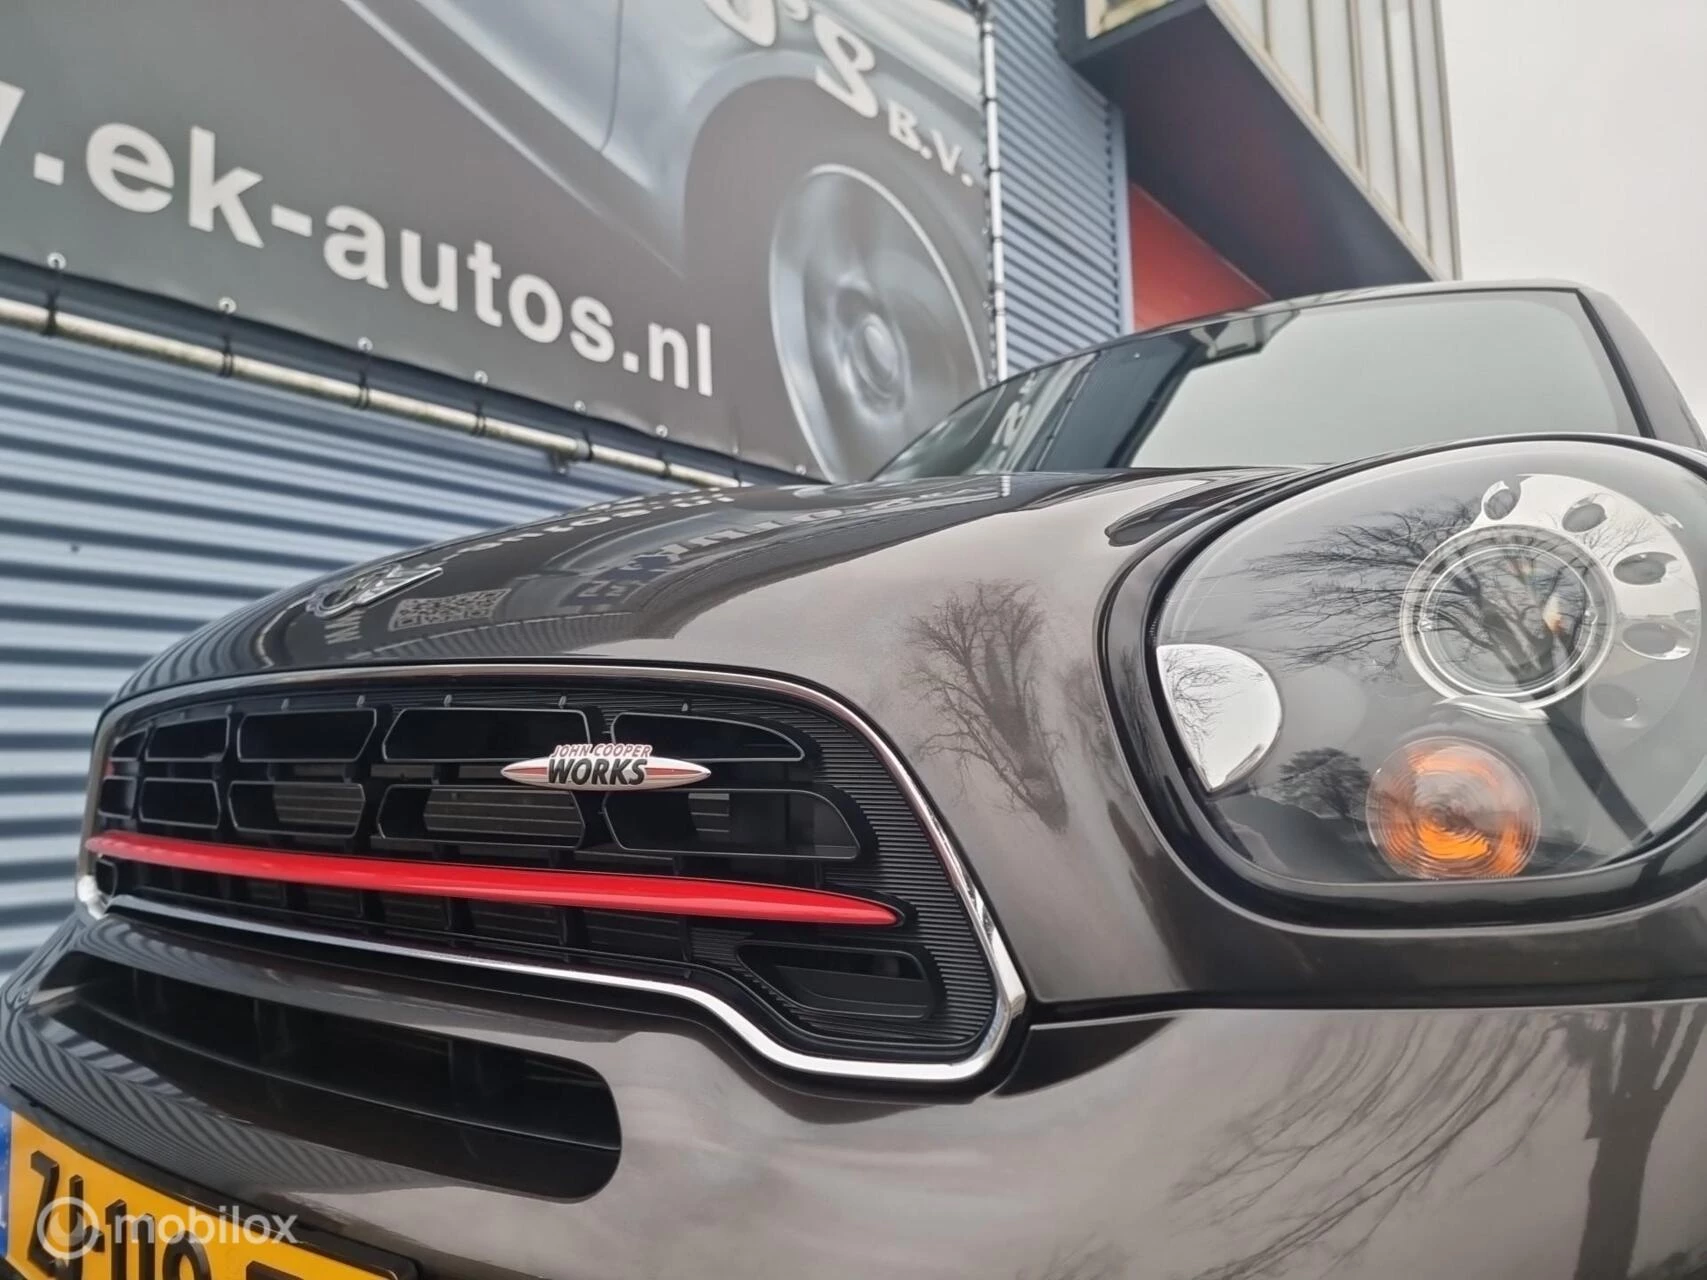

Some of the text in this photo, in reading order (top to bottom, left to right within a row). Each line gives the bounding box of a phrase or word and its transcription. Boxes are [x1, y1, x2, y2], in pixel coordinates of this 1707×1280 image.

[887, 100, 973, 187] B.V.
[0, 80, 713, 397] .ek-autos.nl
[548, 757, 648, 786] WORKS
[551, 743, 652, 758] JOHN COOPER
